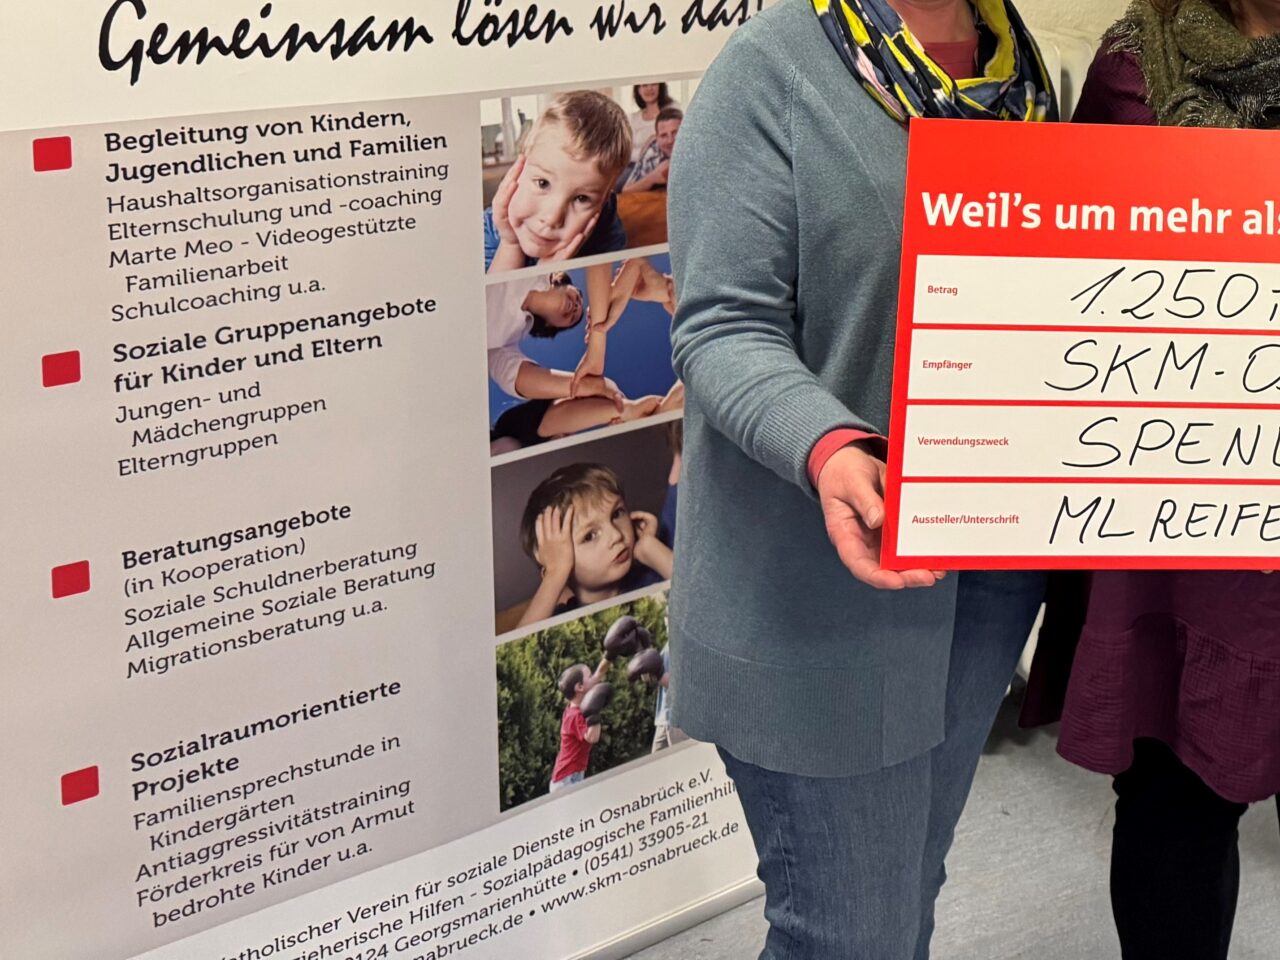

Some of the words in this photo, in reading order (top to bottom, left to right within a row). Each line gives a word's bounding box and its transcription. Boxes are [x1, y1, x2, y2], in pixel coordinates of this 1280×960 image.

[104, 126, 248, 153] Begleitung
[256, 121, 303, 137] von
[310, 111, 410, 133] Kindern,
[106, 150, 286, 184] Jugendlichen
[293, 142, 342, 163] und
[349, 134, 447, 157] Familien
[107, 163, 448, 213] Haushaltsorganisationstraining
[108, 208, 282, 240] Elternschulung
[289, 198, 332, 218] und
[340, 189, 442, 211] -coaching
[109, 247, 176, 268] Marte
[184, 240, 233, 258] Meo
[256, 216, 416, 247] Videogestützte
[1054, 204, 1115, 231] um
[1130, 197, 1233, 235] mehr
[112, 285, 281, 322] Schulcoaching
[288, 280, 325, 295] u.a.
[125, 256, 288, 293] Familienarbeit
[927, 285, 958, 296] Betrag
[113, 333, 206, 362] Soziale
[215, 299, 436, 345] Gruppenangebote
[114, 371, 153, 392] für
[161, 357, 247, 384] Kinder
[254, 343, 304, 367] und
[311, 335, 382, 358] Eltern
[922, 360, 973, 371] Empfänger
[116, 396, 211, 423] Jungen-
[218, 381, 261, 403] und
[132, 399, 327, 447] Mädchengruppen
[118, 434, 278, 476] Elterngruppen
[918, 436, 1009, 447] Verwendungszweck
[122, 506, 351, 569] Beratungsangebote
[912, 514, 1019, 524] Aussteller/Unterschrift
[1049, 496, 1134, 545] ML
[125, 578, 154, 597] (in
[161, 537, 305, 587] Kooperation)
[125, 594, 205, 625] Soziale
[213, 543, 417, 603] Schuldnerberatung
[125, 608, 254, 652] Allgemeine
[262, 586, 336, 616] Soziale
[344, 562, 435, 595] Beratung
[127, 609, 345, 679] Migrationsberatung
[352, 601, 387, 617] u.a.
[131, 682, 400, 772] Sozialraumorientierte
[132, 757, 239, 801] Projekte
[133, 744, 374, 830] Familiensprechstunde
[381, 737, 400, 751] in
[135, 780, 410, 882] Antiaggressivitätstraining
[150, 794, 295, 851] Kindergärten
[137, 854, 262, 907] Förderkreis
[269, 841, 299, 861] für
[305, 826, 345, 847] von
[351, 801, 414, 833] Armut
[222, 918, 342, 960] tholischer
[347, 894, 409, 923] Verein
[415, 881, 441, 900] für
[448, 856, 507, 887] soziale
[513, 827, 574, 861] Dienste
[580, 819, 595, 832] in
[600, 782, 684, 823] Osnabrück
[689, 769, 713, 788] e.V.
[409, 896, 464, 924] Hilfen
[483, 820, 645, 895] Sozialpädagogische
[541, 823, 738, 913] www.skm-osnabrueck.de
[153, 882, 255, 928] bedrohte
[262, 854, 331, 888] Kinder
[337, 843, 372, 861] u.a.
[395, 874, 566, 952] Georgsmarienhütte
[585, 842, 633, 875] (0541)
[639, 812, 708, 851] 33905-21
